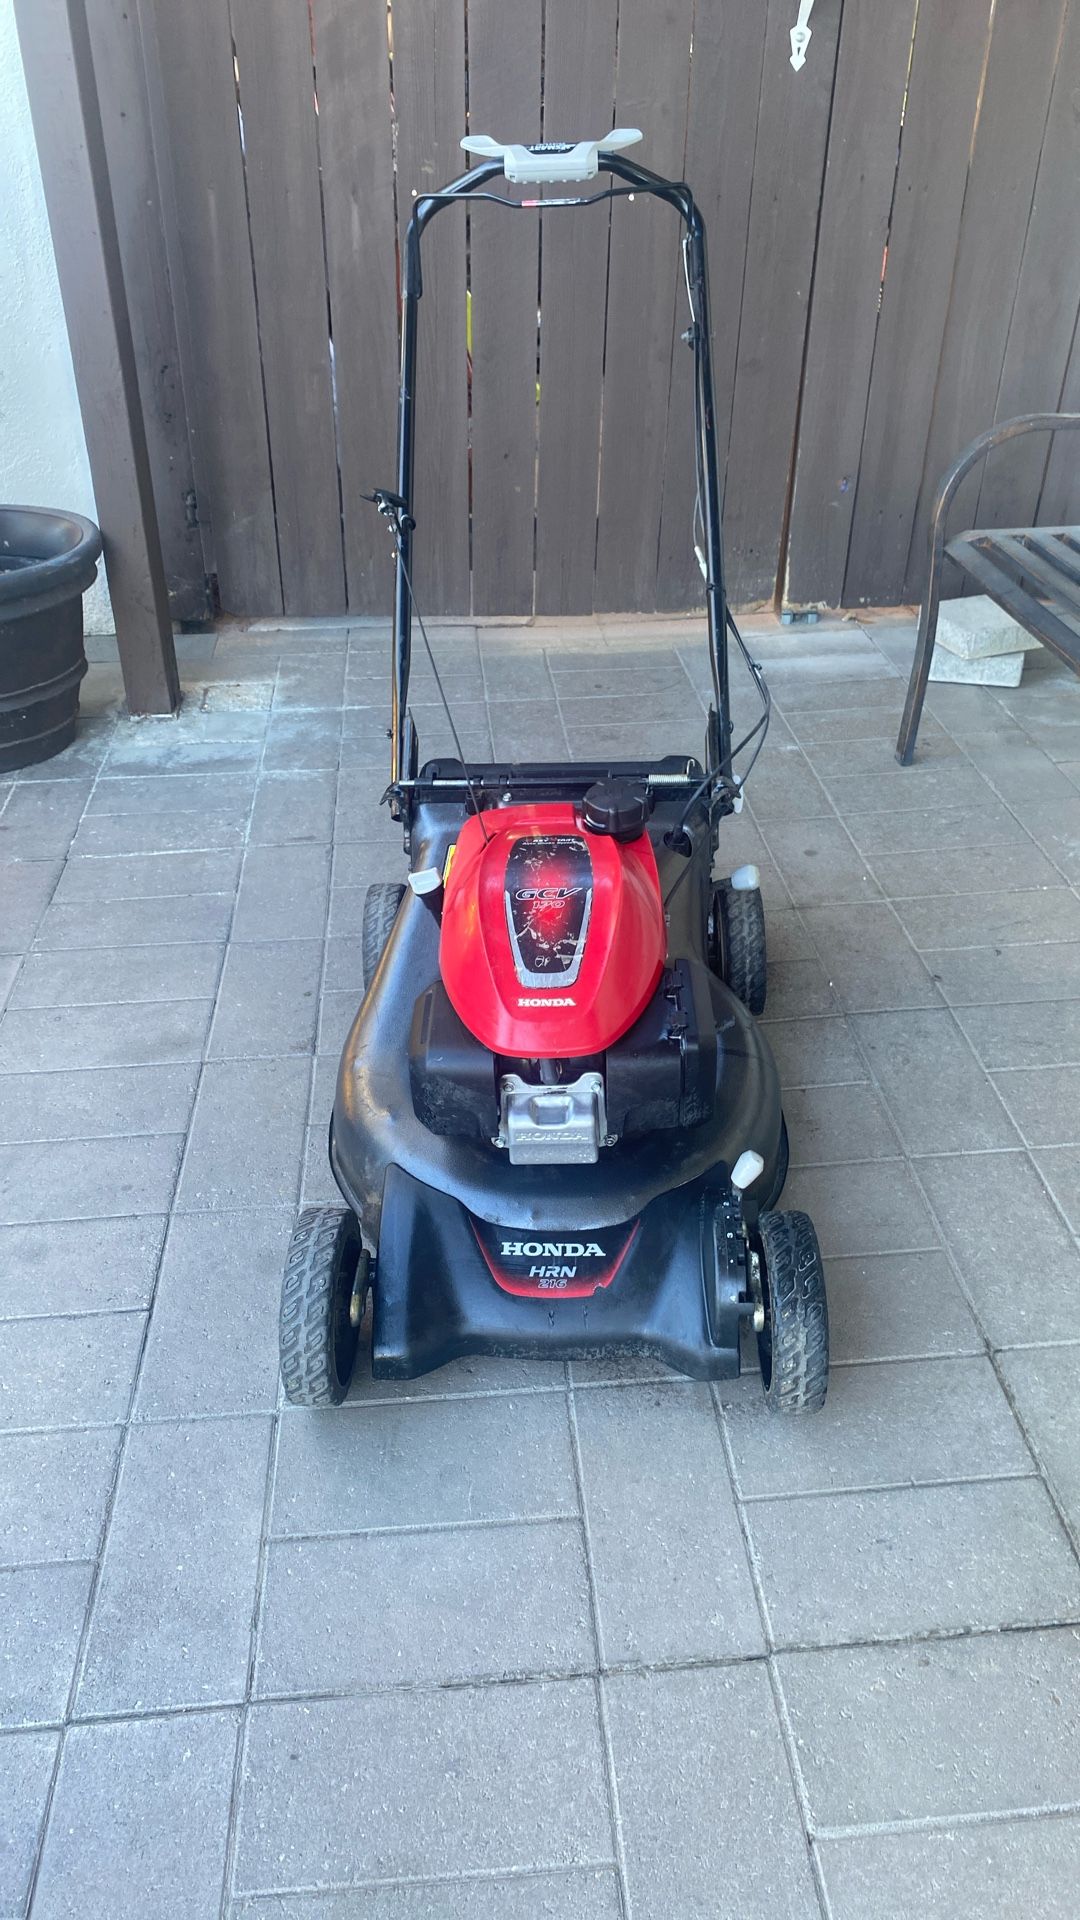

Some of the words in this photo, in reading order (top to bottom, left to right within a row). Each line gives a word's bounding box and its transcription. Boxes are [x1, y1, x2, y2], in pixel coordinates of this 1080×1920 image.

[516, 888, 583, 900] GCV
[533, 901, 565, 909] 170
[517, 998, 576, 1007] HONDA
[515, 1132, 589, 1141] HONDA
[501, 1242, 606, 1257] HONDA
[529, 1266, 576, 1278] HRN
[538, 1279, 567, 1289] 216
